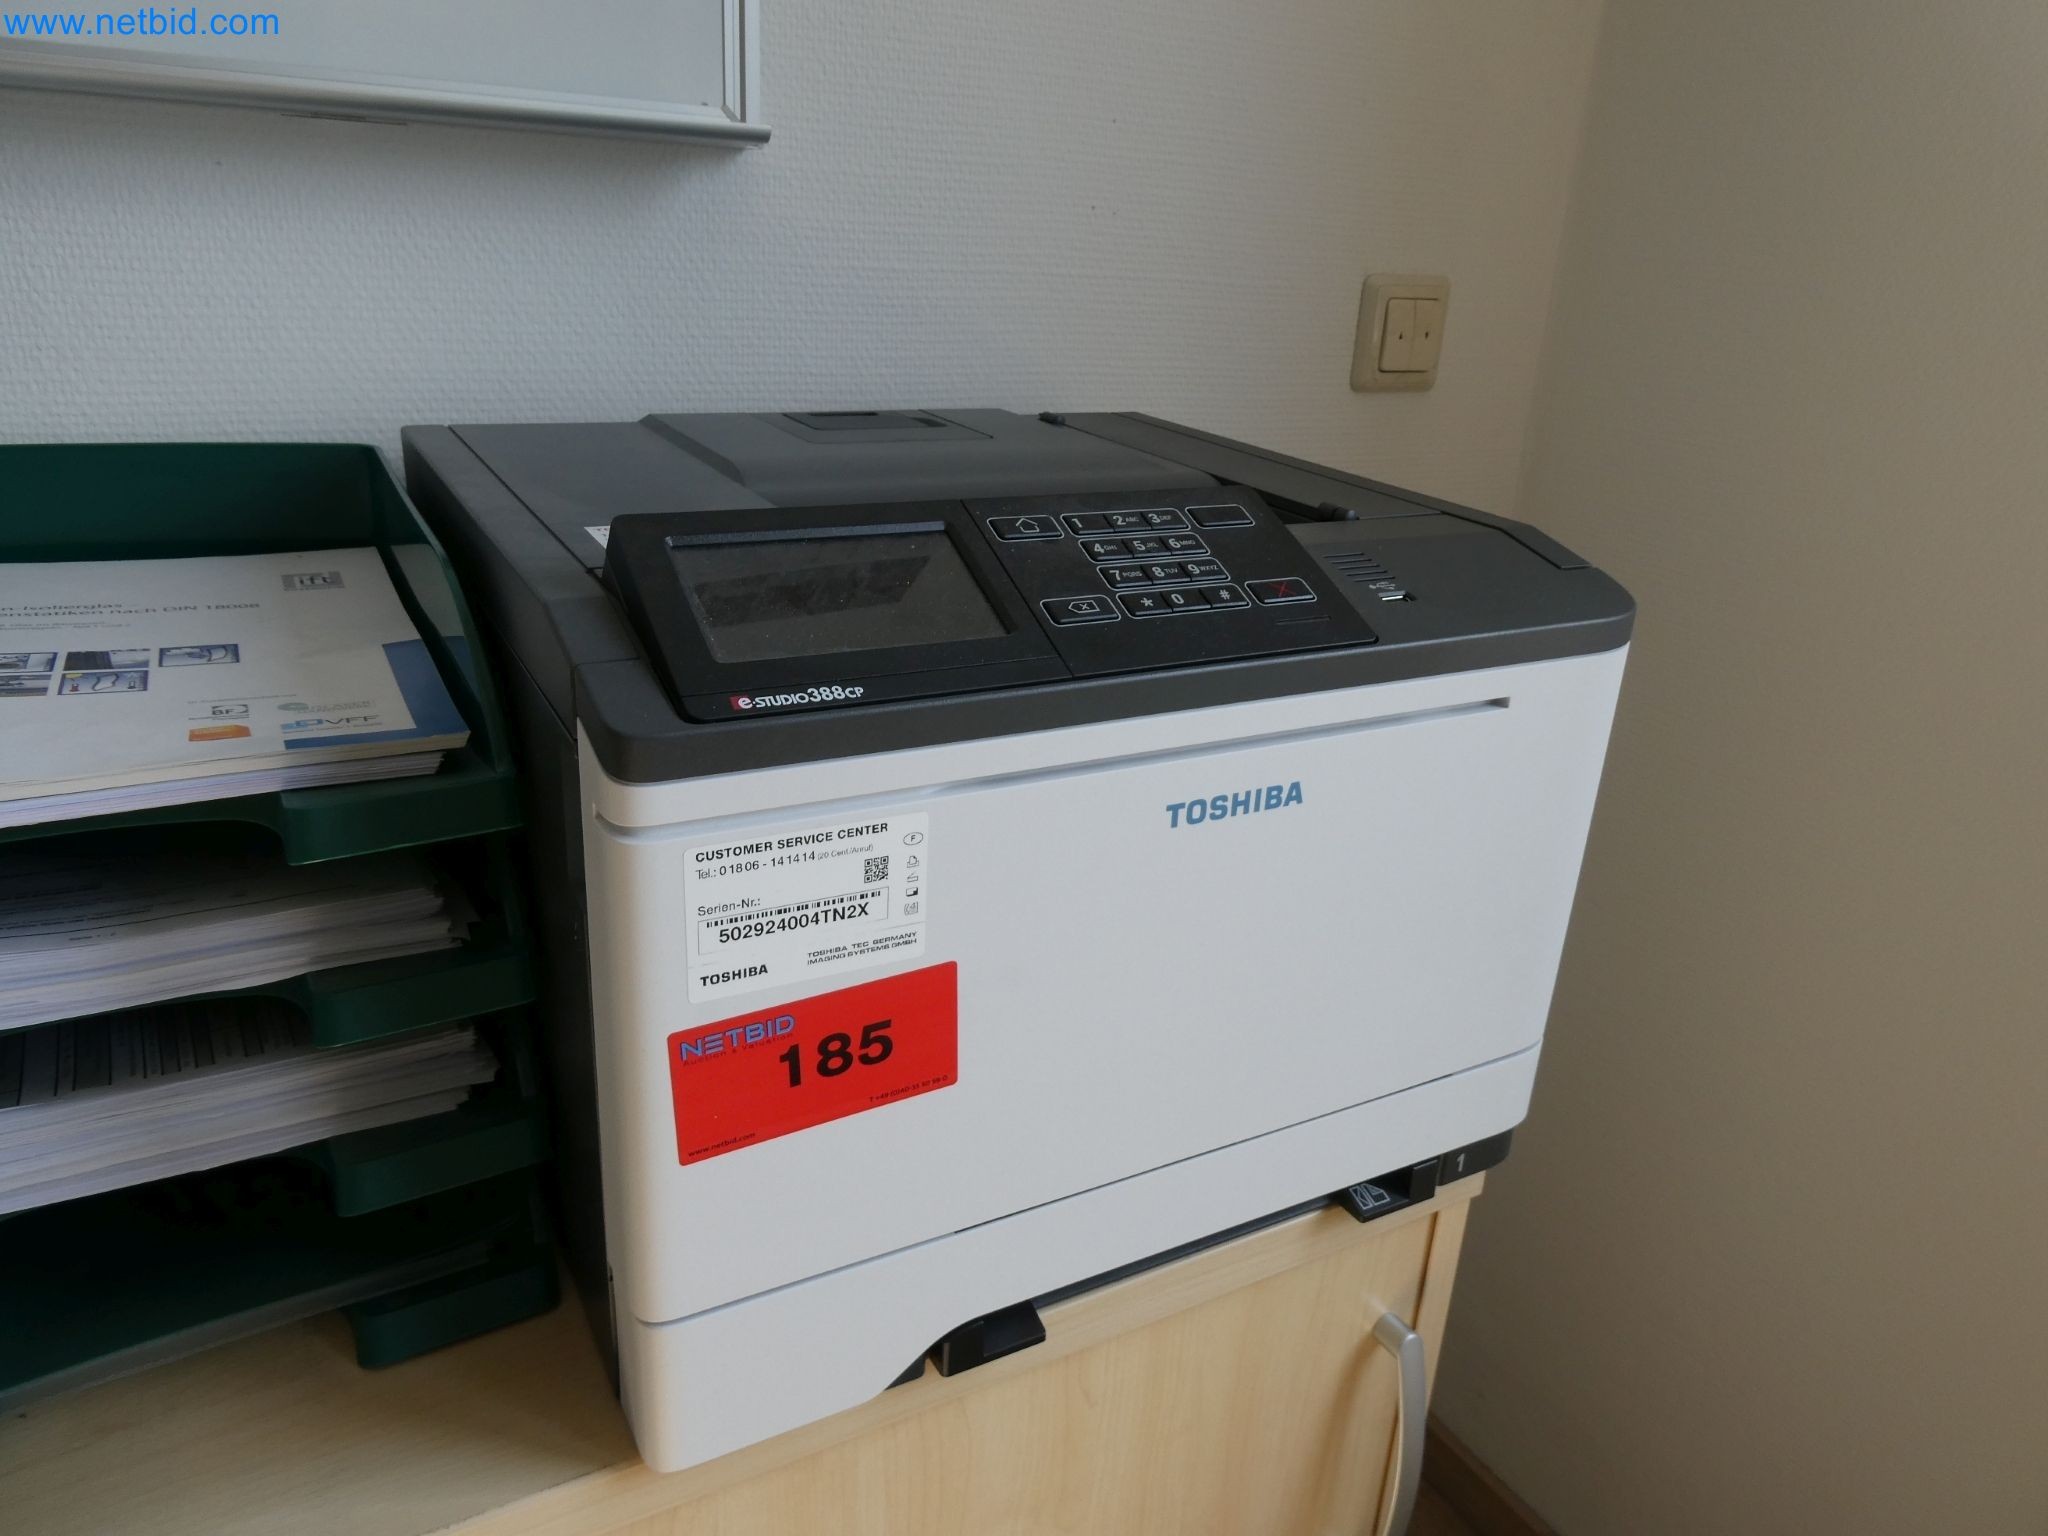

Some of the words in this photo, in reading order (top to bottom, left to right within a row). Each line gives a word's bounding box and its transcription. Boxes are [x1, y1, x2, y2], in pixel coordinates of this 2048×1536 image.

[1072, 518, 1083, 528] 1
[1112, 515, 1126, 525] 2
[1148, 513, 1160, 523] 3
[1094, 543, 1105, 553] 4
[1133, 540, 1146, 551] 5
[1169, 538, 1181, 548] 6
[1110, 570, 1121, 581] 7
[1152, 566, 1165, 577] 8
[1187, 563, 1200, 574] 9
[1170, 593, 1185, 605] 0
[1166, 781, 1303, 828] TOSHIBA
[695, 841, 773, 863] CUSTOMER
[777, 832, 833, 850] SERVICE
[837, 822, 888, 840] CENTER
[695, 868, 717, 880] Tel.:
[698, 896, 761, 917] Serien-Nr.:
[719, 902, 869, 944] 502924004TN2X
[807, 953, 846, 965] IMAGING
[847, 944, 890, 957] SYSTEMS
[808, 945, 848, 958] TOSHIBA
[852, 941, 869, 949] TEC
[872, 931, 918, 945] GERMANY
[700, 964, 768, 986] TOSHIBA
[680, 1014, 796, 1062] NETBID
[779, 1019, 894, 1088] 185
[688, 1131, 756, 1157] www.netbid.com
[1456, 1153, 1465, 1172] 1
